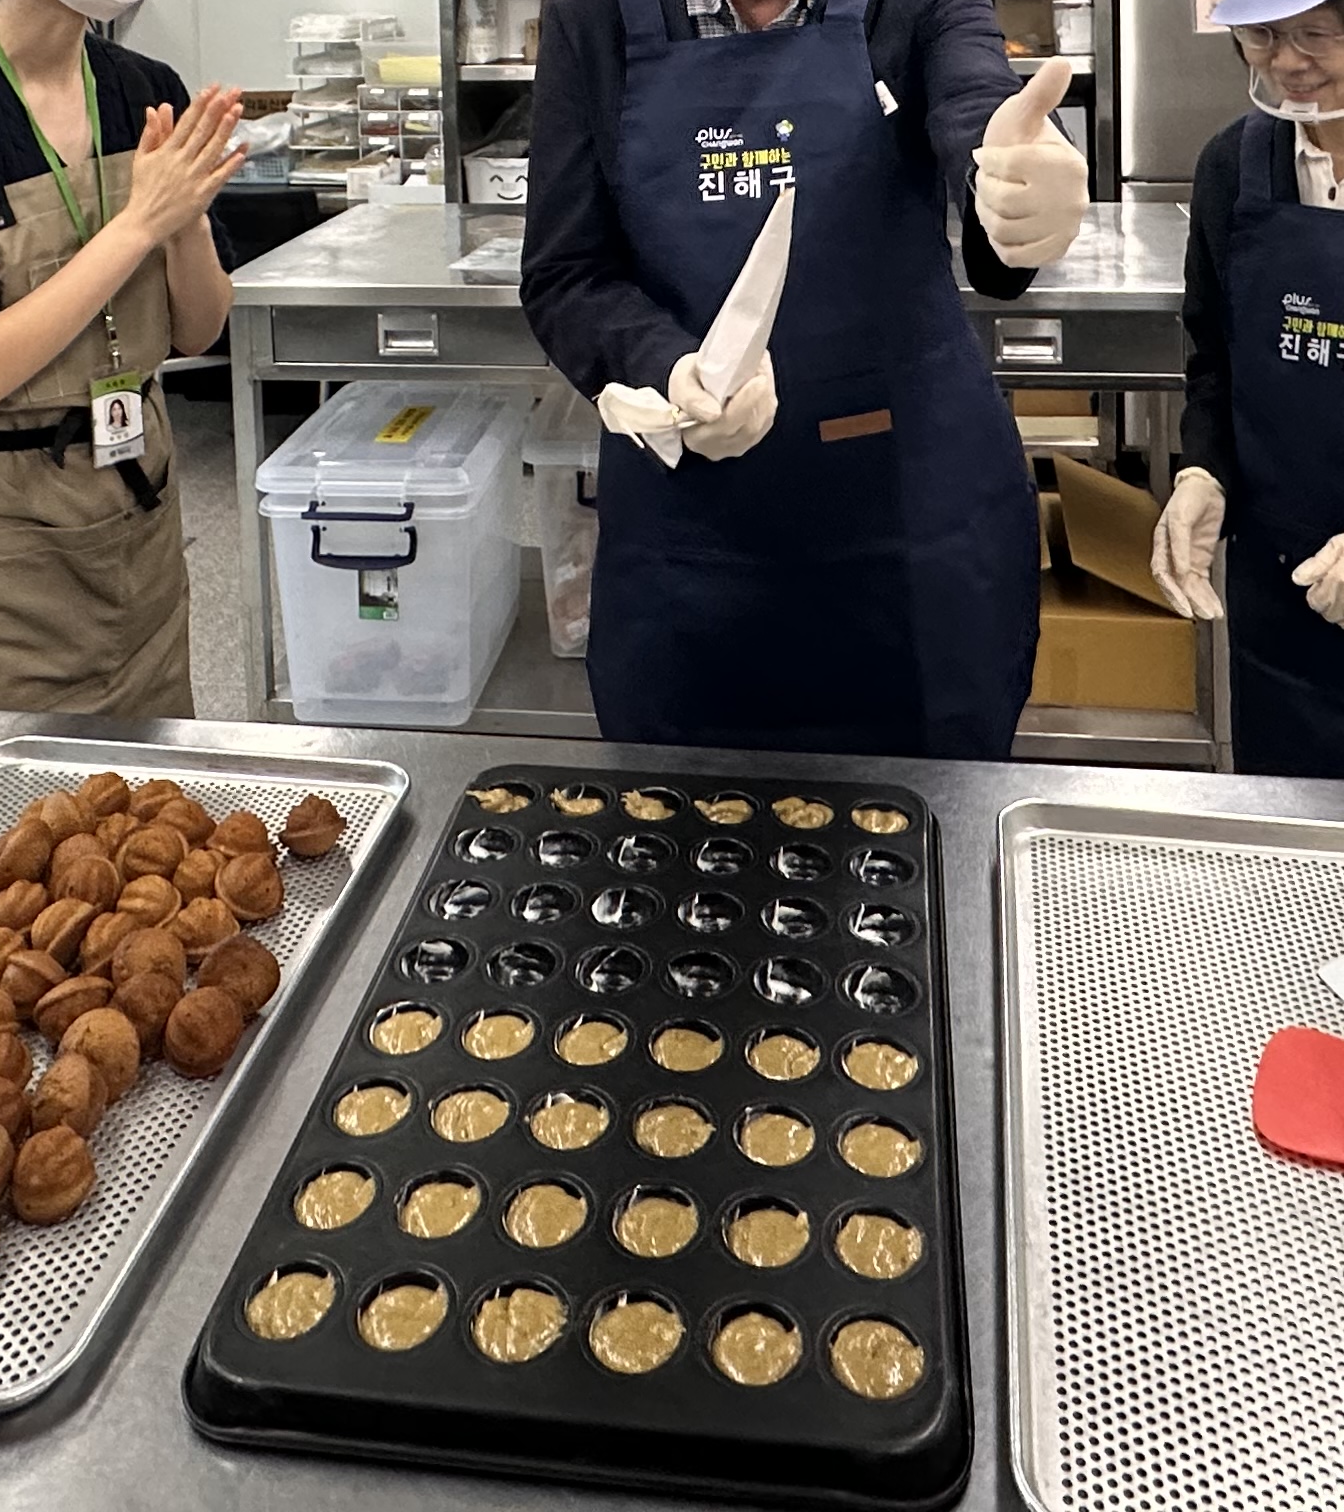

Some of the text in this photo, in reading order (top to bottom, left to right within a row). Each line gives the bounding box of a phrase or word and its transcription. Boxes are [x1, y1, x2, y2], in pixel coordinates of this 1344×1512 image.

[695, 126, 733, 143] plus
[700, 151, 738, 170] 구민과
[1282, 316, 1314, 334] 구민과
